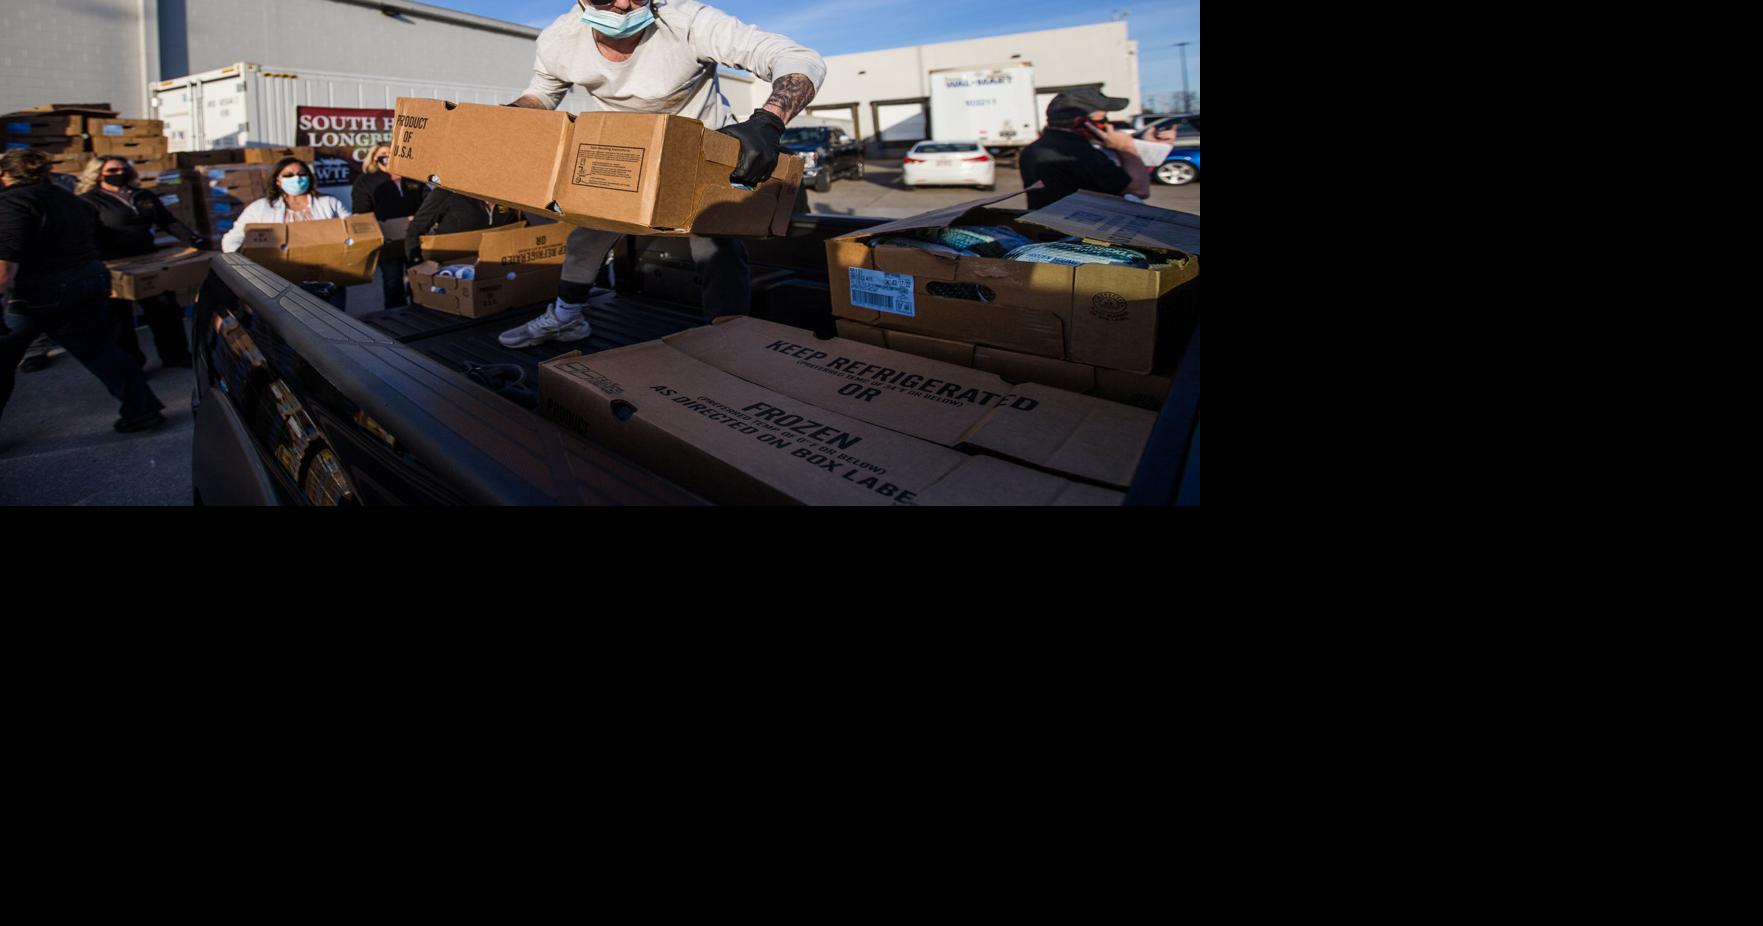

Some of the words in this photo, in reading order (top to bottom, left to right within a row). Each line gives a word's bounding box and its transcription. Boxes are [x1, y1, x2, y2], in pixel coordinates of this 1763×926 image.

[299, 115, 377, 131] SOUTH
[396, 114, 429, 130] PRODUCT
[403, 131, 413, 143] OF
[393, 145, 414, 160] U.S.A.
[315, 166, 350, 180] WTF
[765, 339, 826, 361] KEEP
[827, 356, 1039, 411] REFRIGERATED
[838, 382, 882, 402] OR
[923, 393, 963, 408] BELOW)
[650, 384, 678, 397] AS
[671, 395, 759, 435] DIRECTED
[757, 432, 792, 449] ON
[791, 448, 844, 473] BOX
[741, 401, 863, 450] FROZEN
[697, 395, 752, 421] (PREFERRED
[818, 446, 837, 455] OR
[837, 452, 887, 475] BELOW)
